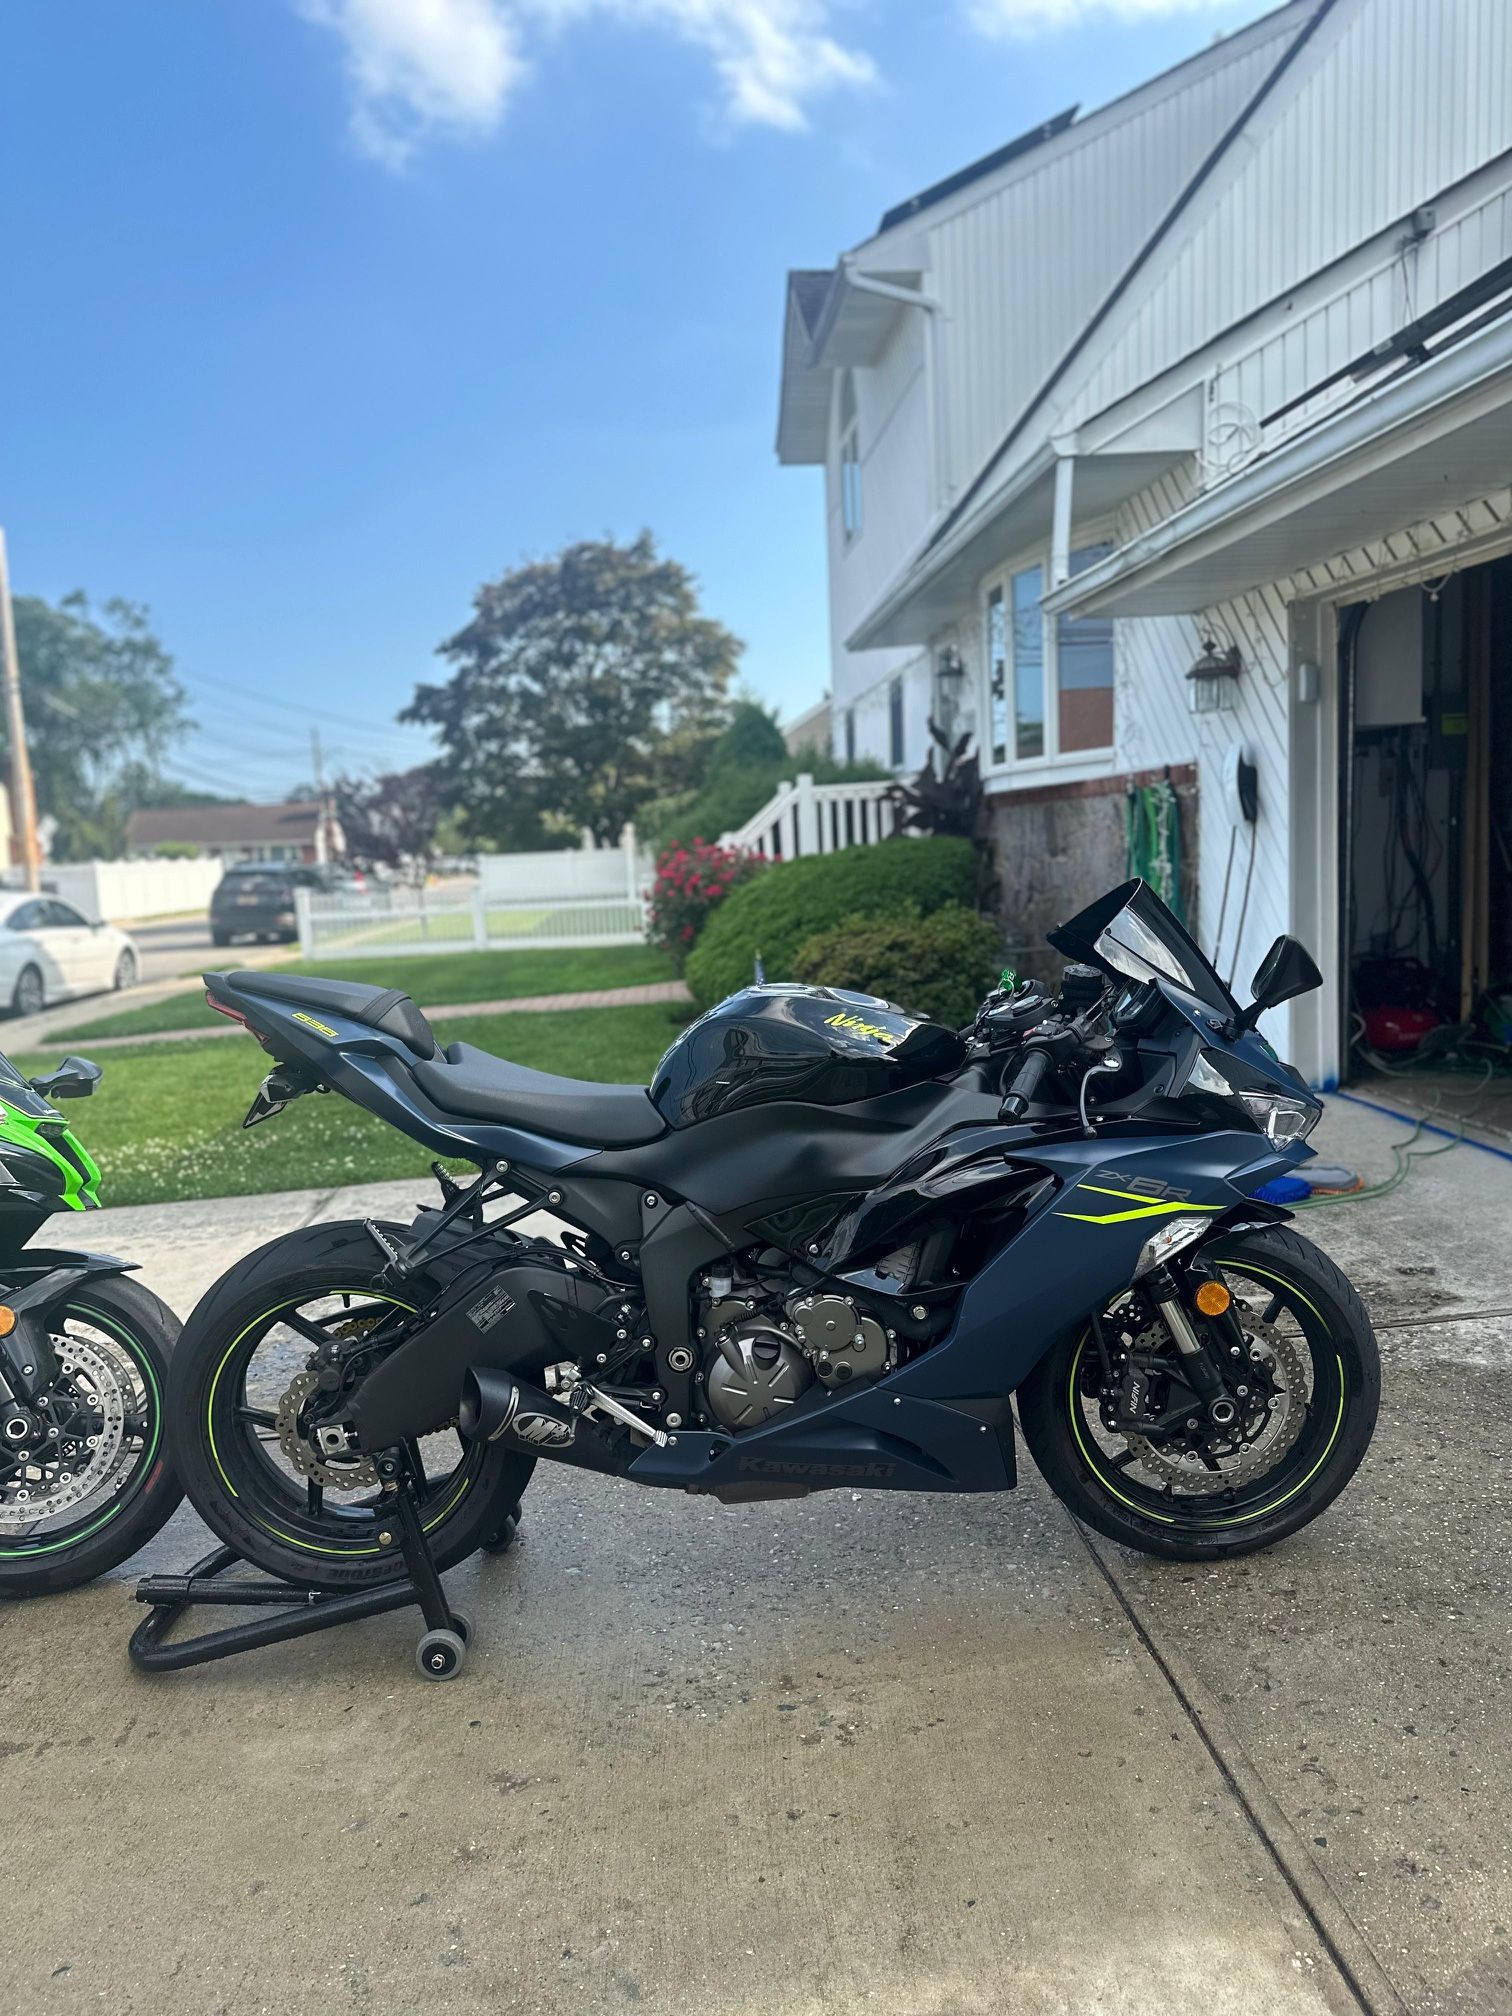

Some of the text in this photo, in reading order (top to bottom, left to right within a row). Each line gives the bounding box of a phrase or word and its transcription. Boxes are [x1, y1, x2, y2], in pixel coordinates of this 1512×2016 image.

[291, 1012, 340, 1038] 636
[823, 1013, 894, 1044] Ninja
[736, 1456, 898, 1478] Kawasaki
